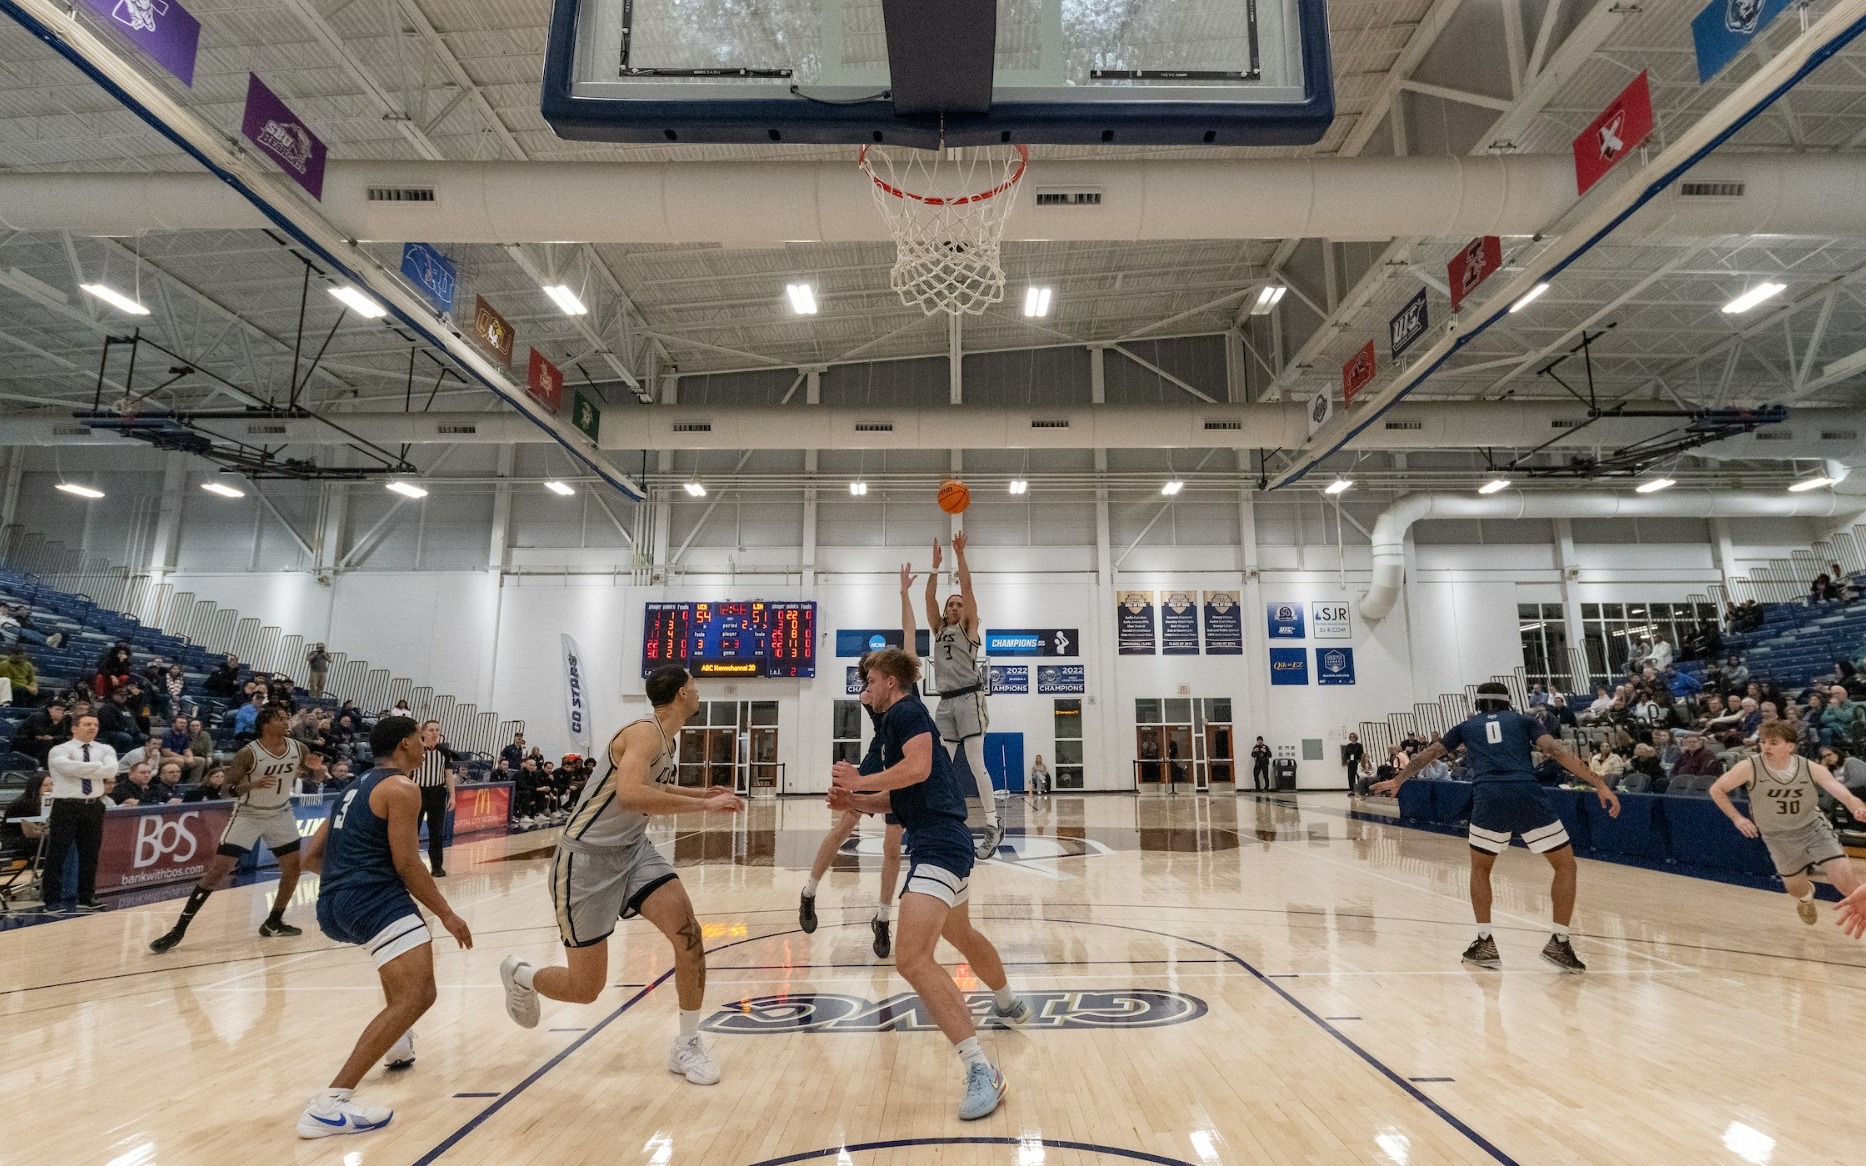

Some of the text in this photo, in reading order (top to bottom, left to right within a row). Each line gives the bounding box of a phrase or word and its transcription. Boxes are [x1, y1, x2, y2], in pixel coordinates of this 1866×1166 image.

[264, 120, 293, 148] SBU
[682, 611, 688, 620] 0
[696, 611, 711, 623] 54
[752, 611, 767, 623] 51
[777, 610, 812, 620] 0 22 0
[1322, 607, 1347, 621] SJR
[741, 620, 748, 630] 2
[697, 639, 703, 649] 3
[991, 638, 1037, 648] CHAMPIONS
[943, 645, 953, 660] 3
[571, 710, 582, 733] GO
[1485, 721, 1503, 744] 0
[264, 763, 294, 775] UIS
[276, 778, 282, 794] 1
[1767, 789, 1804, 798] UIS
[333, 788, 358, 829] 3
[1776, 799, 1800, 815] 30
[121, 864, 205, 885] bankwithbos.com
